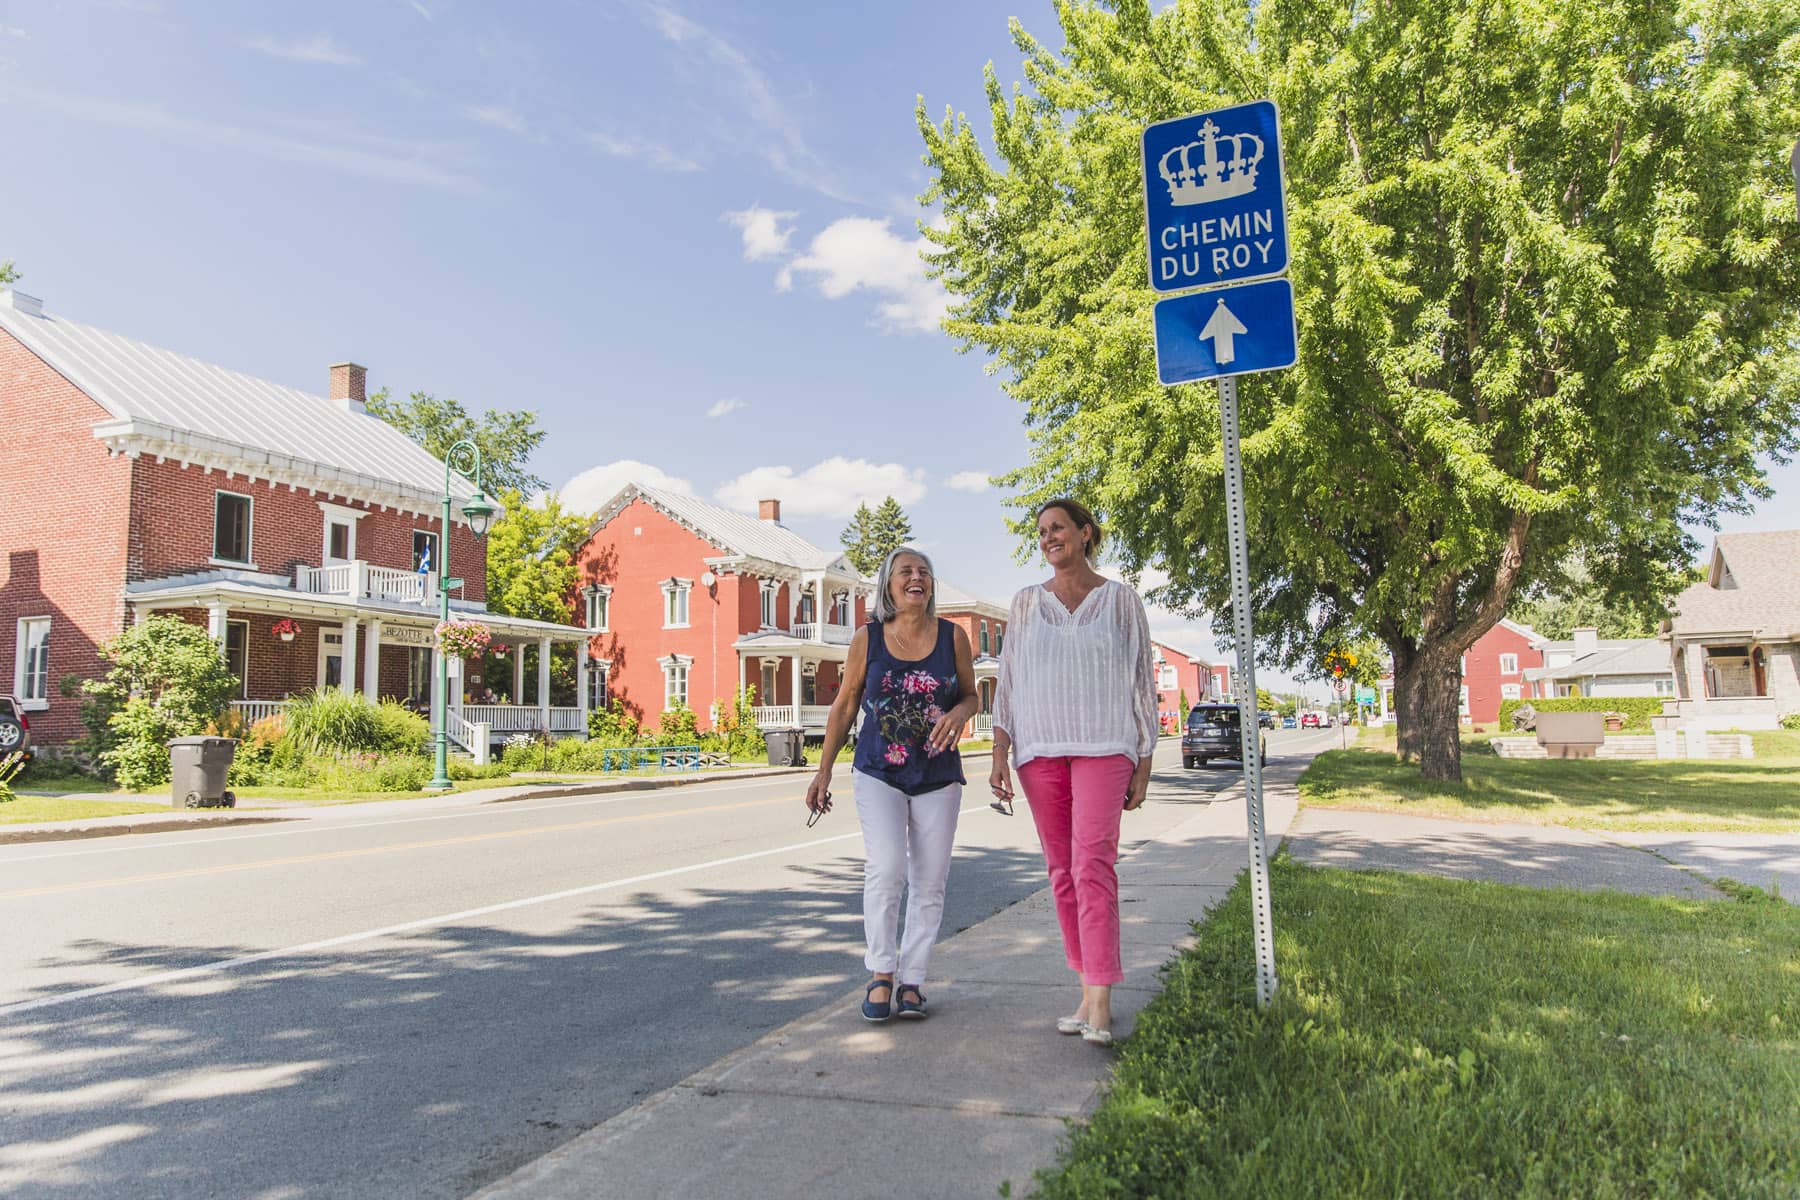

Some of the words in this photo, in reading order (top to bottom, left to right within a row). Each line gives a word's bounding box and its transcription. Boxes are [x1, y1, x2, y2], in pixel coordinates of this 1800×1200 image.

[1161, 209, 1272, 250] CHEMIN
[1161, 252, 1200, 280] DU
[1212, 238, 1274, 272] ROY
